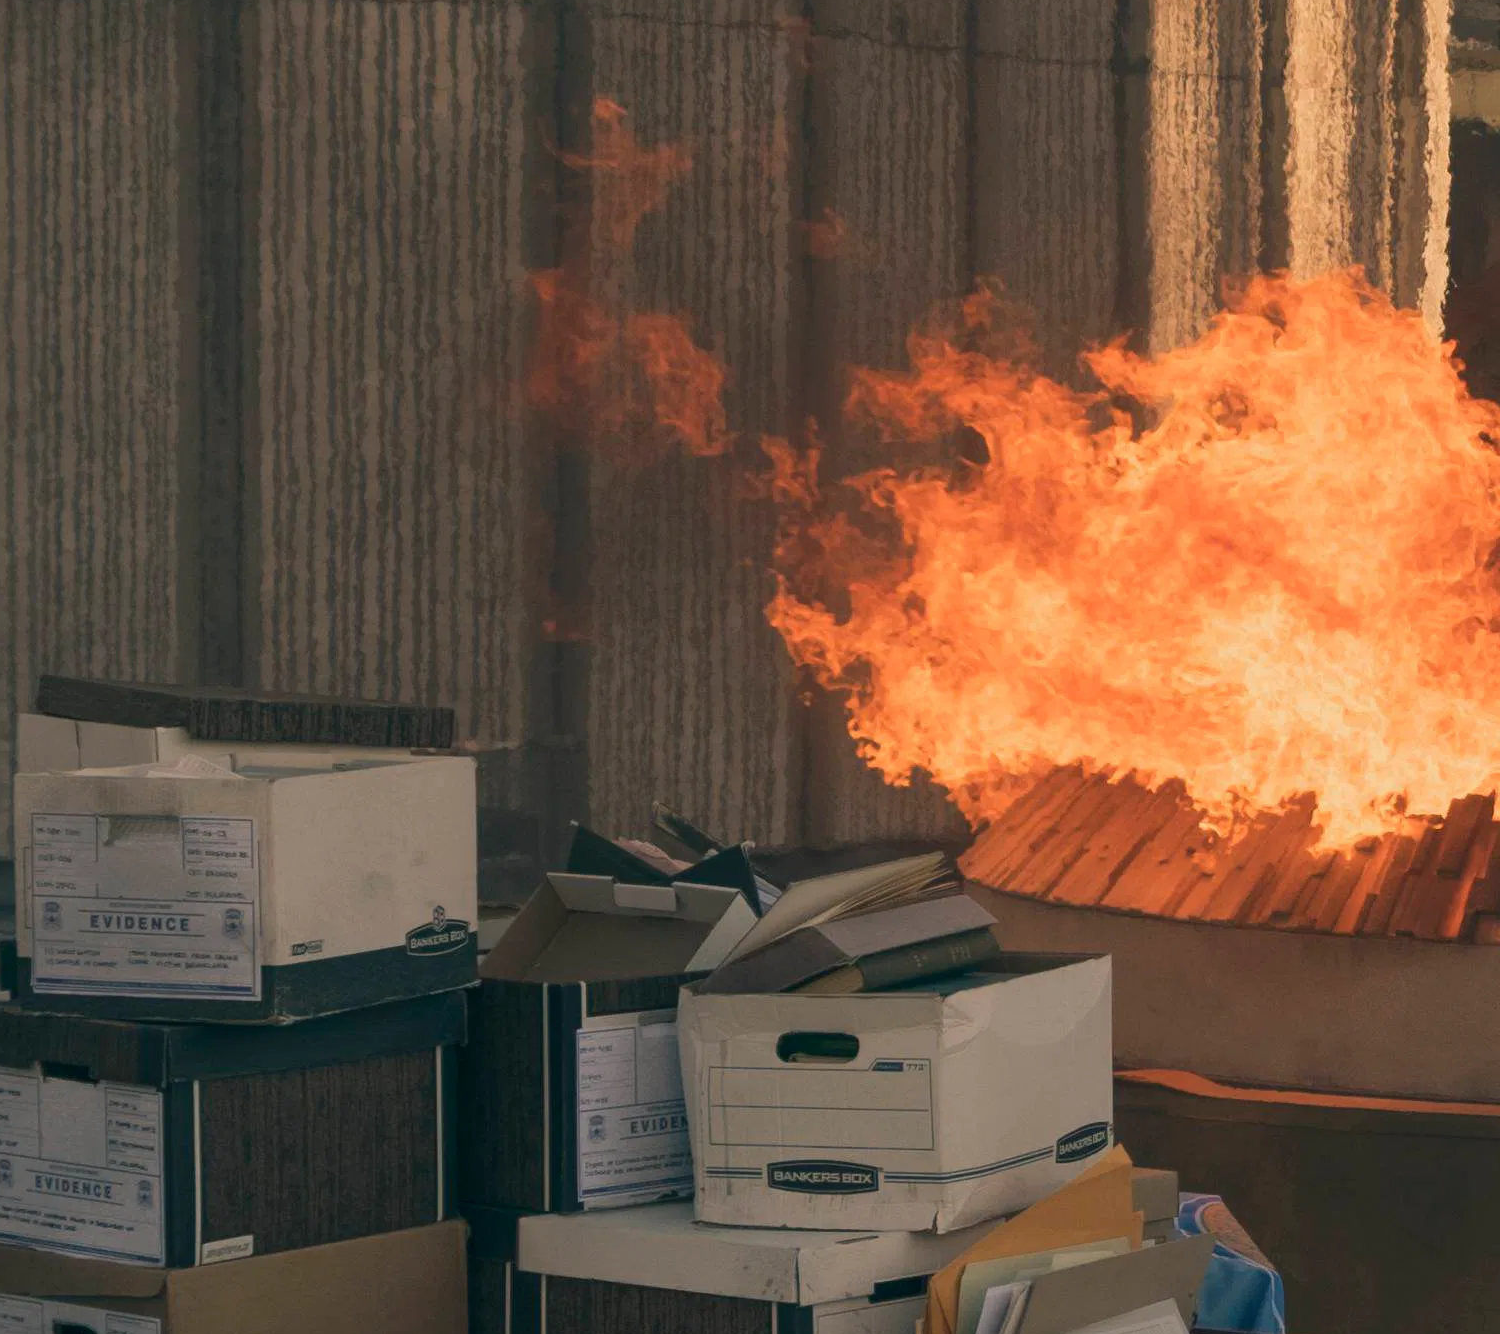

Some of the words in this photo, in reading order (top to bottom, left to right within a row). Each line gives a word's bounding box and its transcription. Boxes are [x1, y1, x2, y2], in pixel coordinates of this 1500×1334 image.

[90, 914, 190, 932] EVIDENCE
[411, 933, 448, 949] BANKERS
[450, 929, 466, 943] BOX
[774, 1170, 841, 1184] BANKERS
[843, 1171, 872, 1184] BOX
[35, 1175, 112, 1200] EVIDENCE
